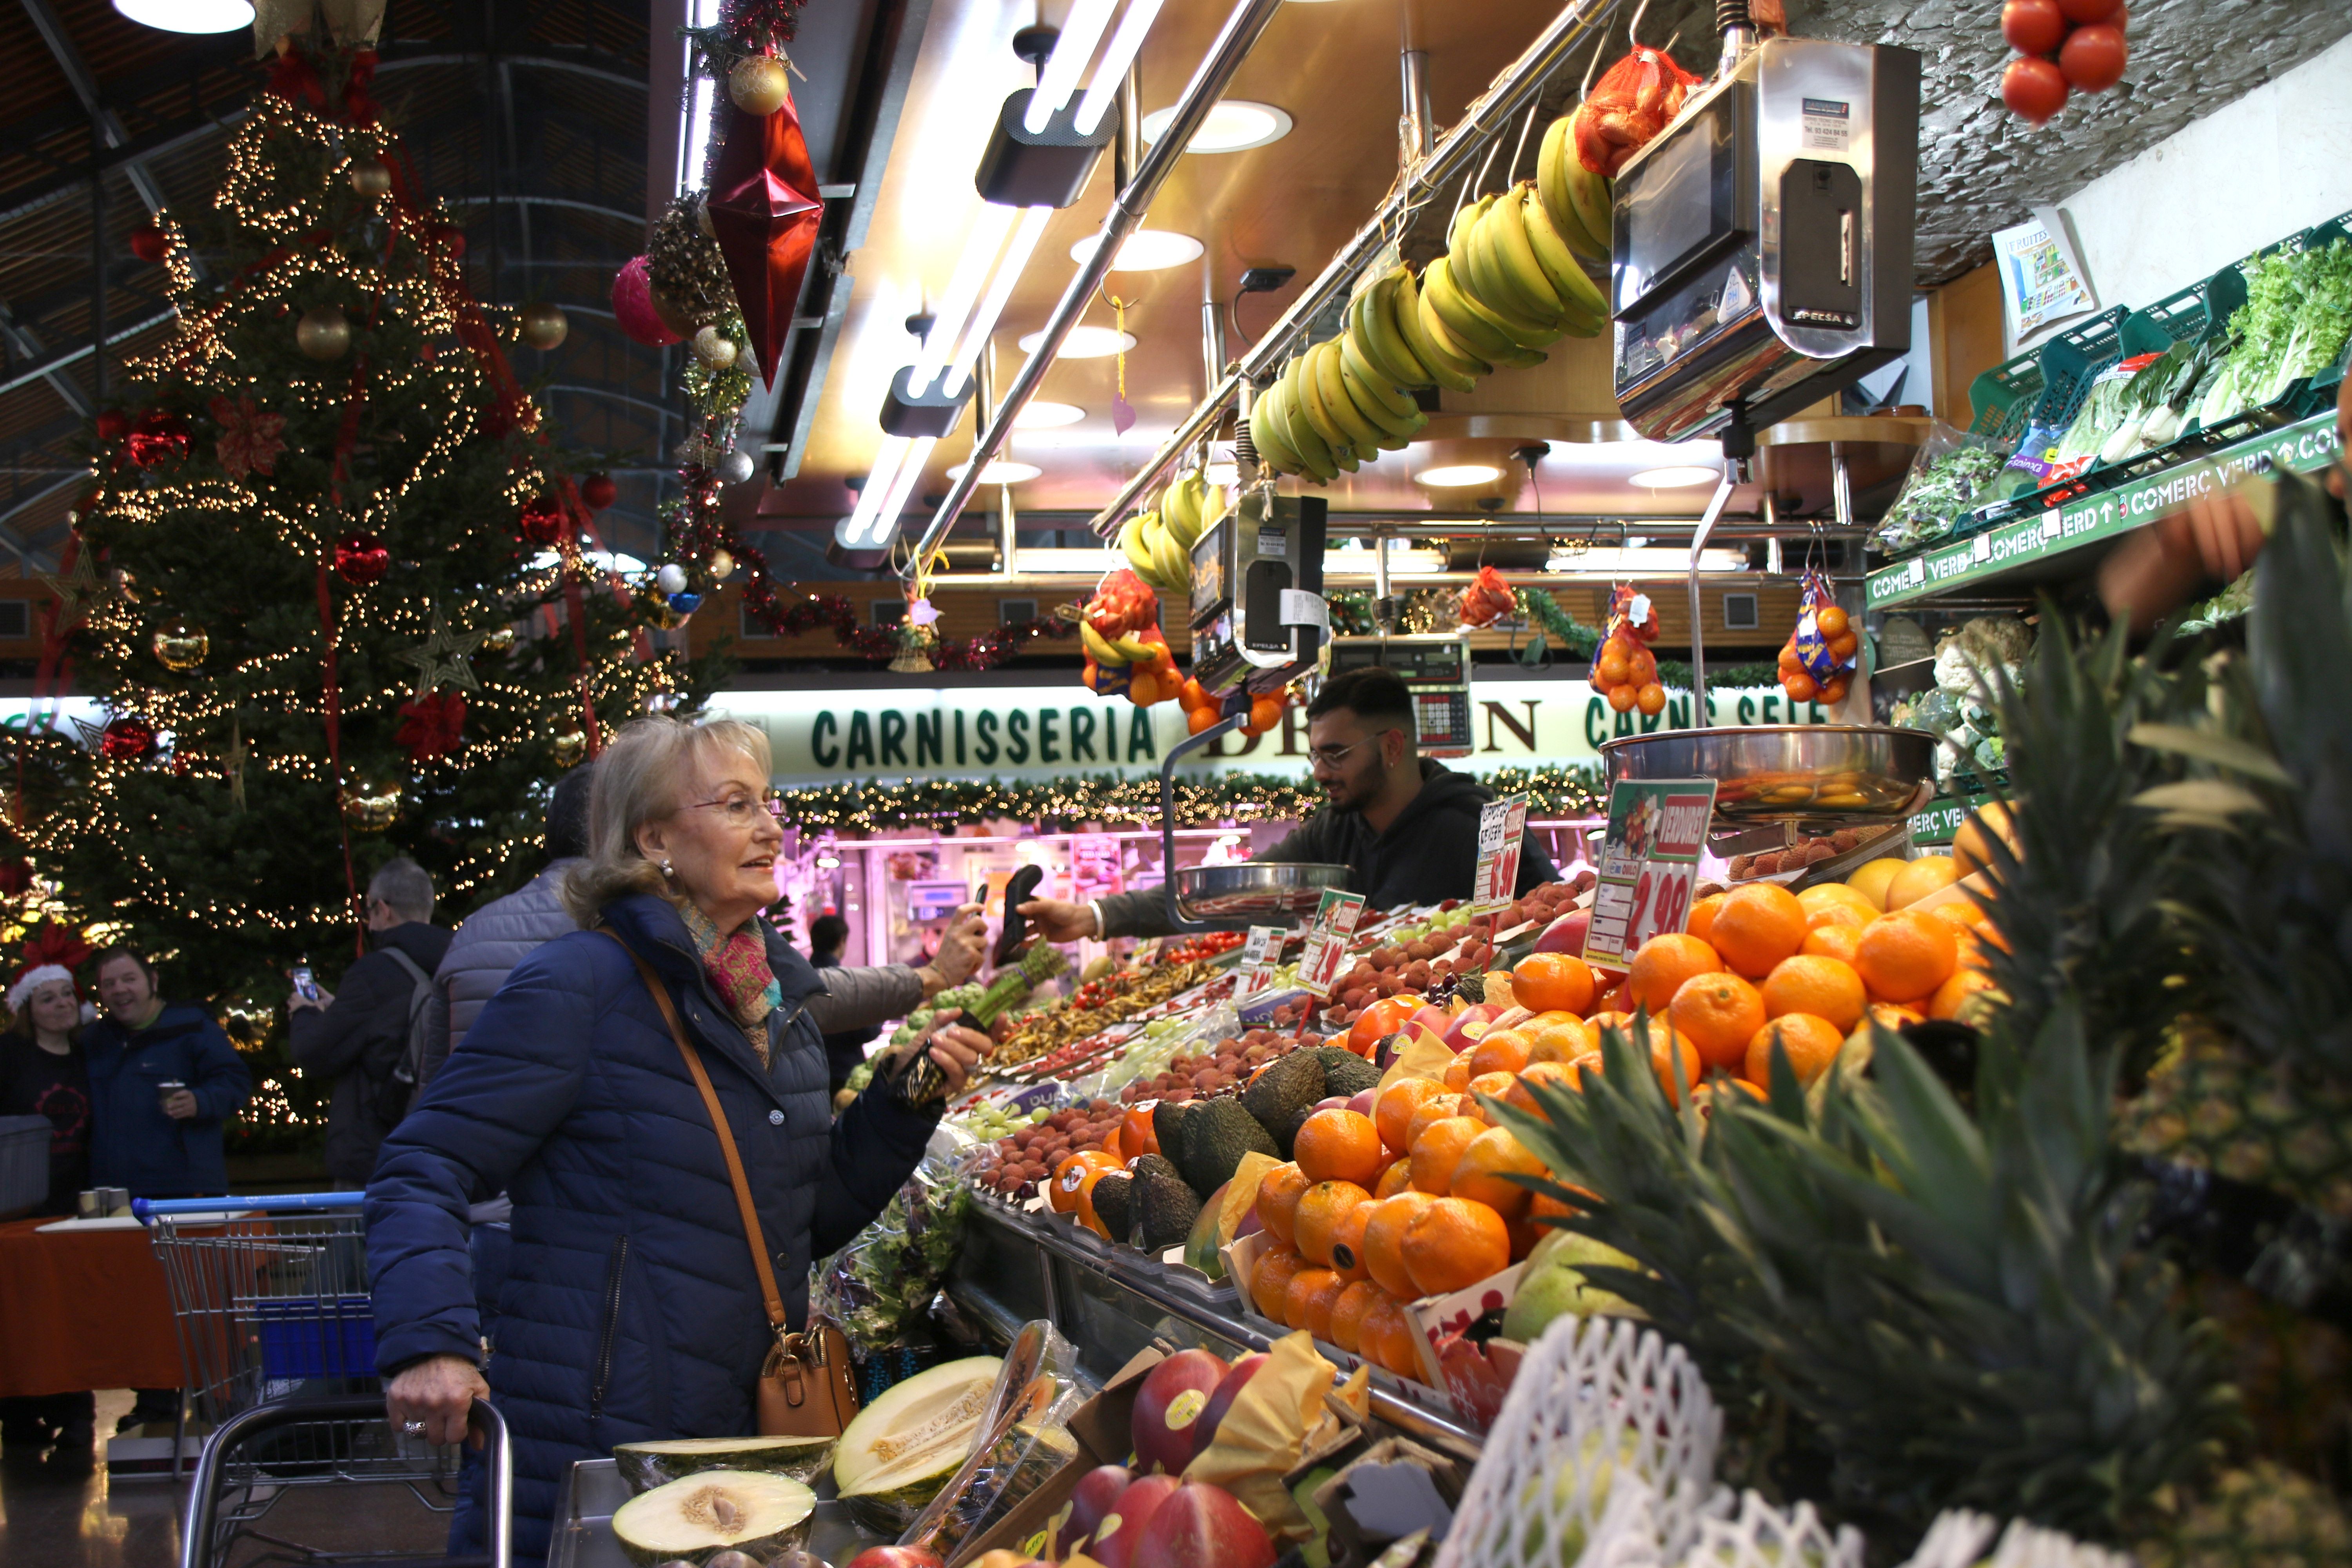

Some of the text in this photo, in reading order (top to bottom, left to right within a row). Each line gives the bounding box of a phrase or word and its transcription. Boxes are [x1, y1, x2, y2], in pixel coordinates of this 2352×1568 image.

[2009, 229, 2049, 253] FRUITES
[1728, 288, 1738, 307] PH
[2057, 508, 2097, 541] ERD
[2130, 470, 2211, 516] COMERÇ
[811, 706, 1155, 768] CARNISSERIA
[1659, 804, 1708, 845] VERDURES
[1621, 864, 1638, 876] QUILO
